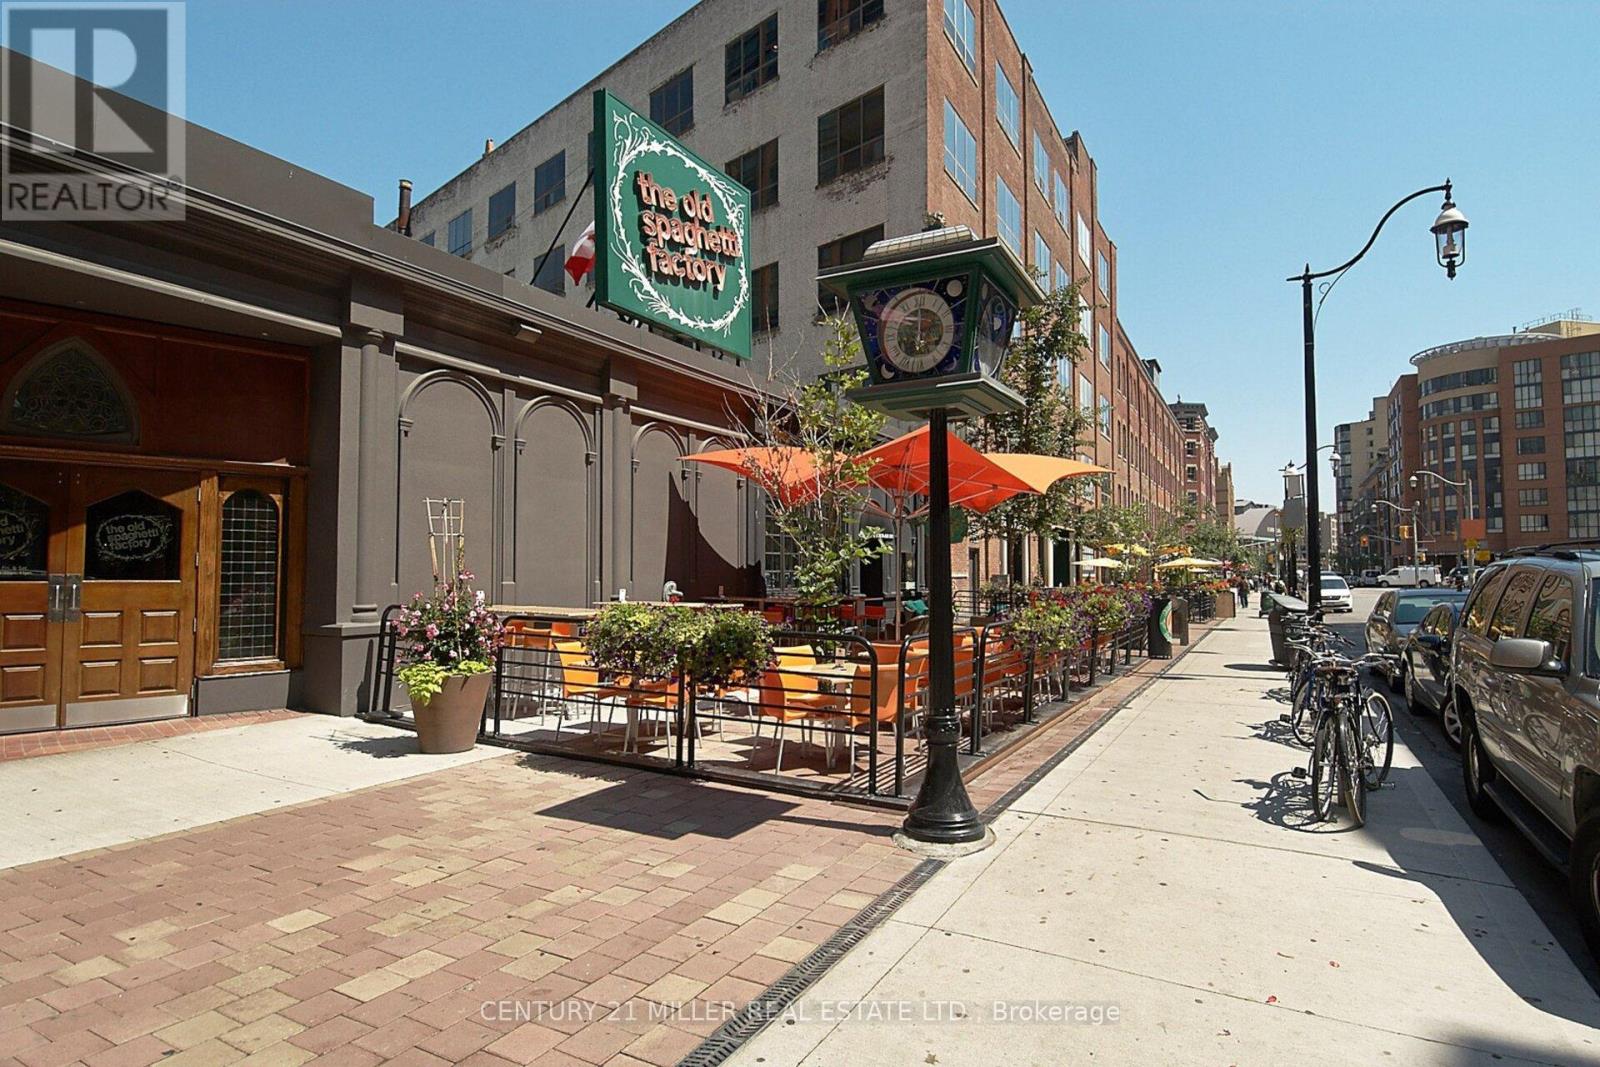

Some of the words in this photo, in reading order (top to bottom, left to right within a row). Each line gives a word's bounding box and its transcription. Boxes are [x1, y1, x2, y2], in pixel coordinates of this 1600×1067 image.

[637, 169, 677, 211] the
[683, 188, 715, 223] old
[642, 209, 742, 257] spaghetti
[646, 238, 726, 291] factory
[105, 523, 126, 534] the
[127, 521, 146, 531] old
